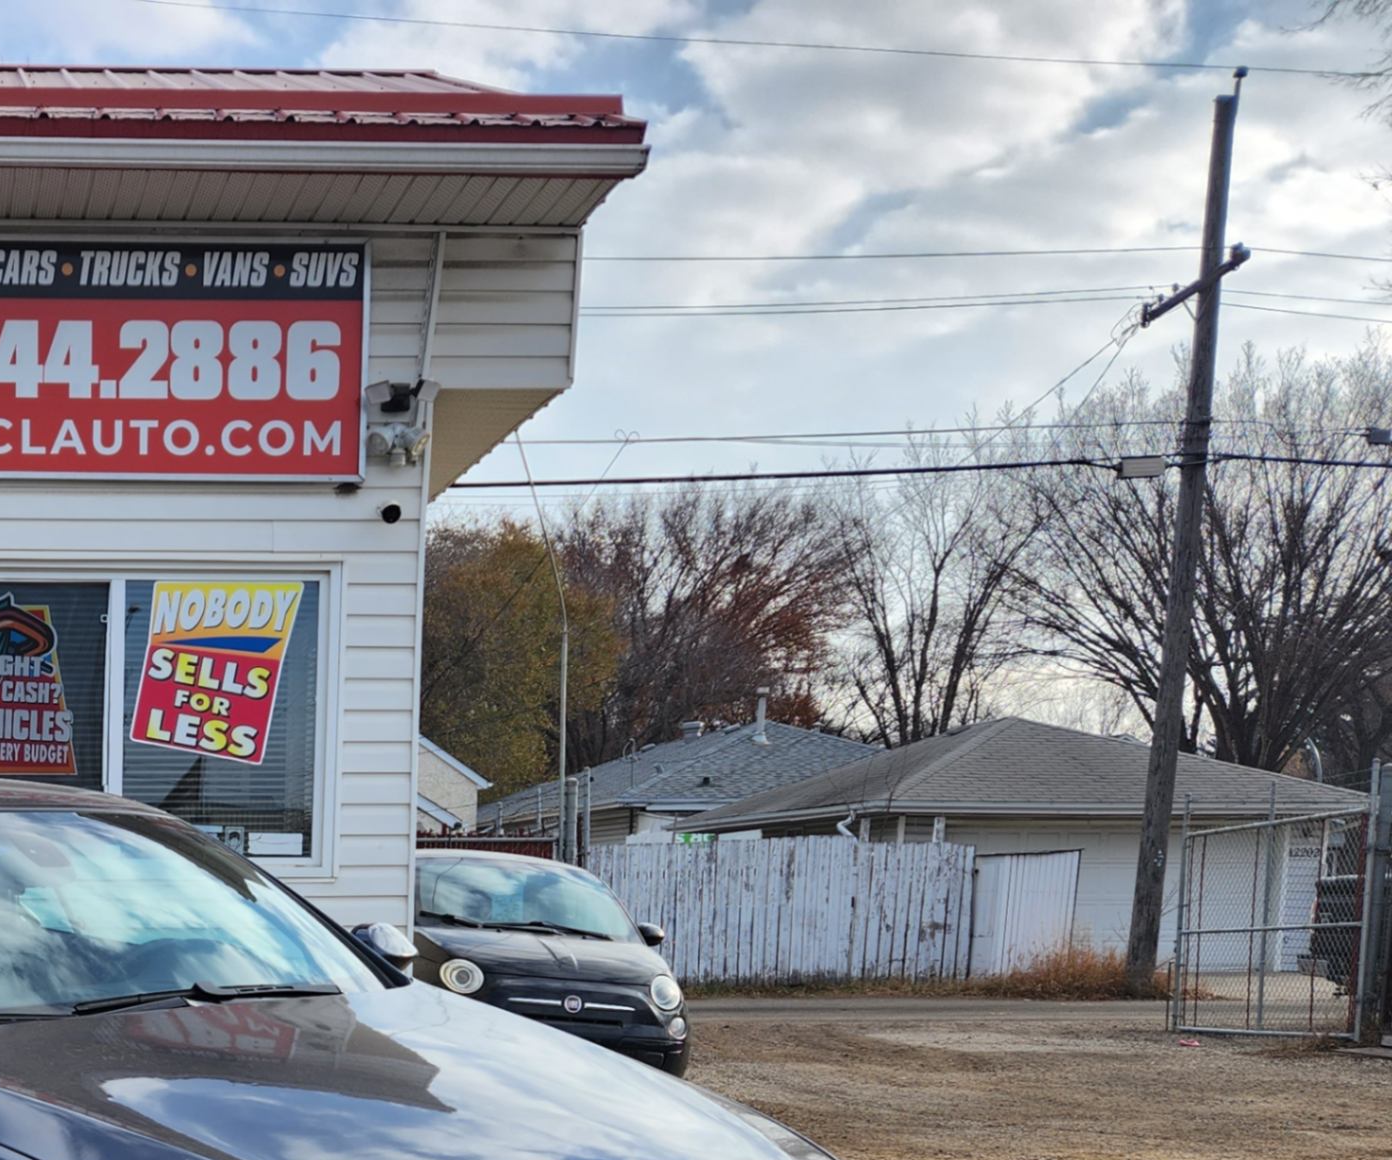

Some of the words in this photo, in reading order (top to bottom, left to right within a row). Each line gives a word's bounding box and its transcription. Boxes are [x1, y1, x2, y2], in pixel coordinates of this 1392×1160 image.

[79, 250, 181, 287] TRUCKS
[202, 251, 270, 288] VANS
[289, 252, 360, 288] SUVS
[152, 587, 298, 636] NOBODY
[1, 680, 62, 705] CASH?
[148, 647, 272, 700] SELLS
[173, 688, 232, 718] FOR
[145, 707, 258, 759] LESS
[23, 742, 70, 764] BUDGET
